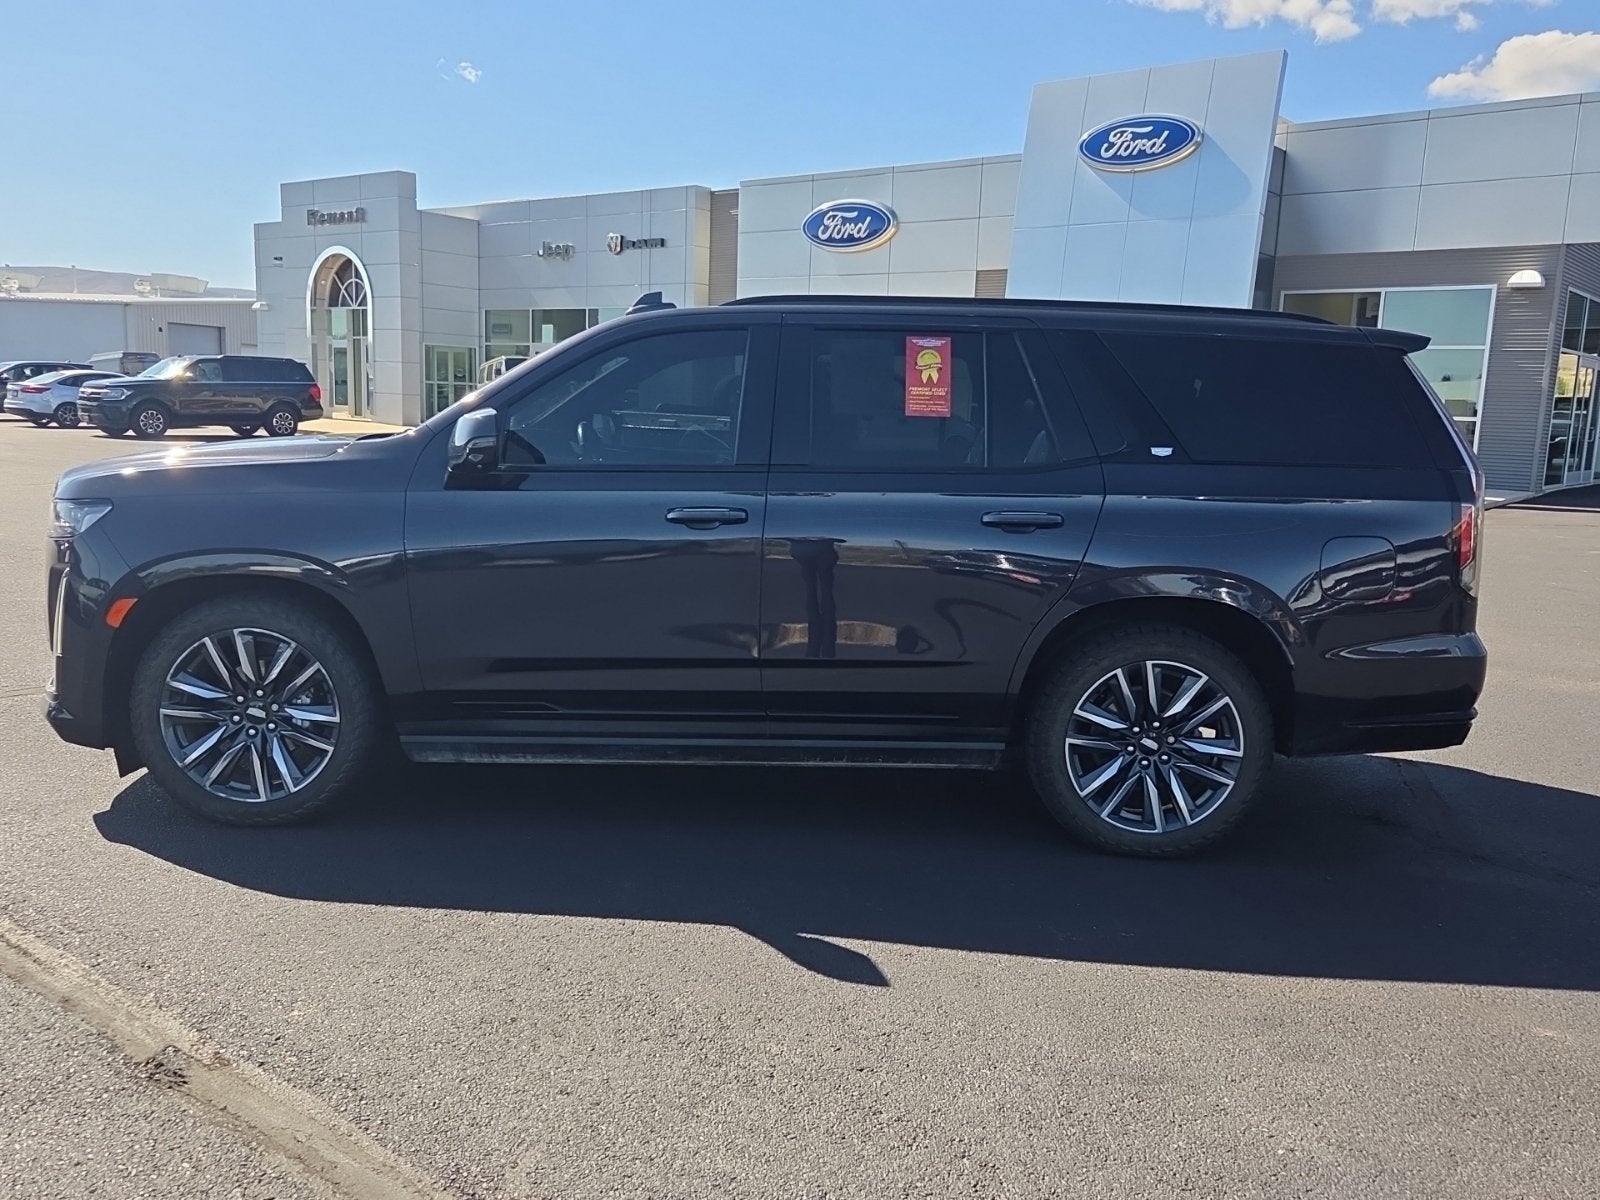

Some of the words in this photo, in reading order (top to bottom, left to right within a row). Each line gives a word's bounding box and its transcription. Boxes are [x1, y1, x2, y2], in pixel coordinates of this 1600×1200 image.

[1100, 126, 1170, 158] Ford
[818, 211, 871, 240] Ford
[537, 240, 576, 261] Jeep
[623, 238, 666, 249] RAM
